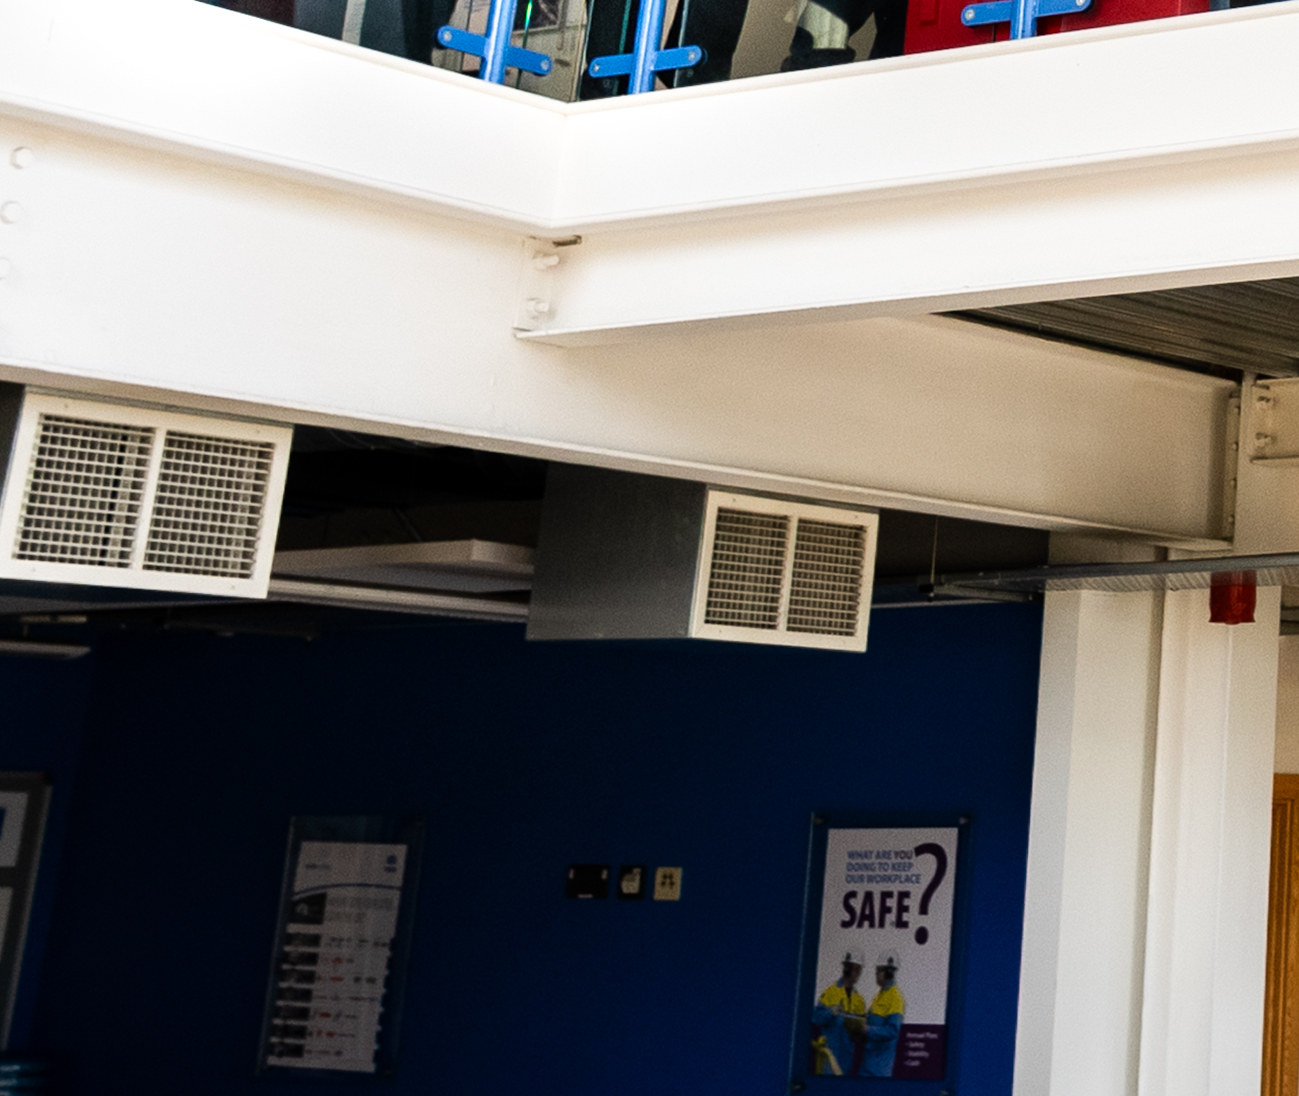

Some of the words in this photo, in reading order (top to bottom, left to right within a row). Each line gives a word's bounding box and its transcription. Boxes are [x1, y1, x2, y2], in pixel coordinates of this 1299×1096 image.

[847, 849, 873, 860] WHAT
[875, 849, 892, 860] ARE
[894, 849, 913, 860] YOU
[846, 861, 876, 872] DOING
[878, 861, 889, 872] TO
[891, 861, 914, 872] KEEP
[845, 873, 865, 884] OUR
[866, 873, 921, 884] WORKPLACE
